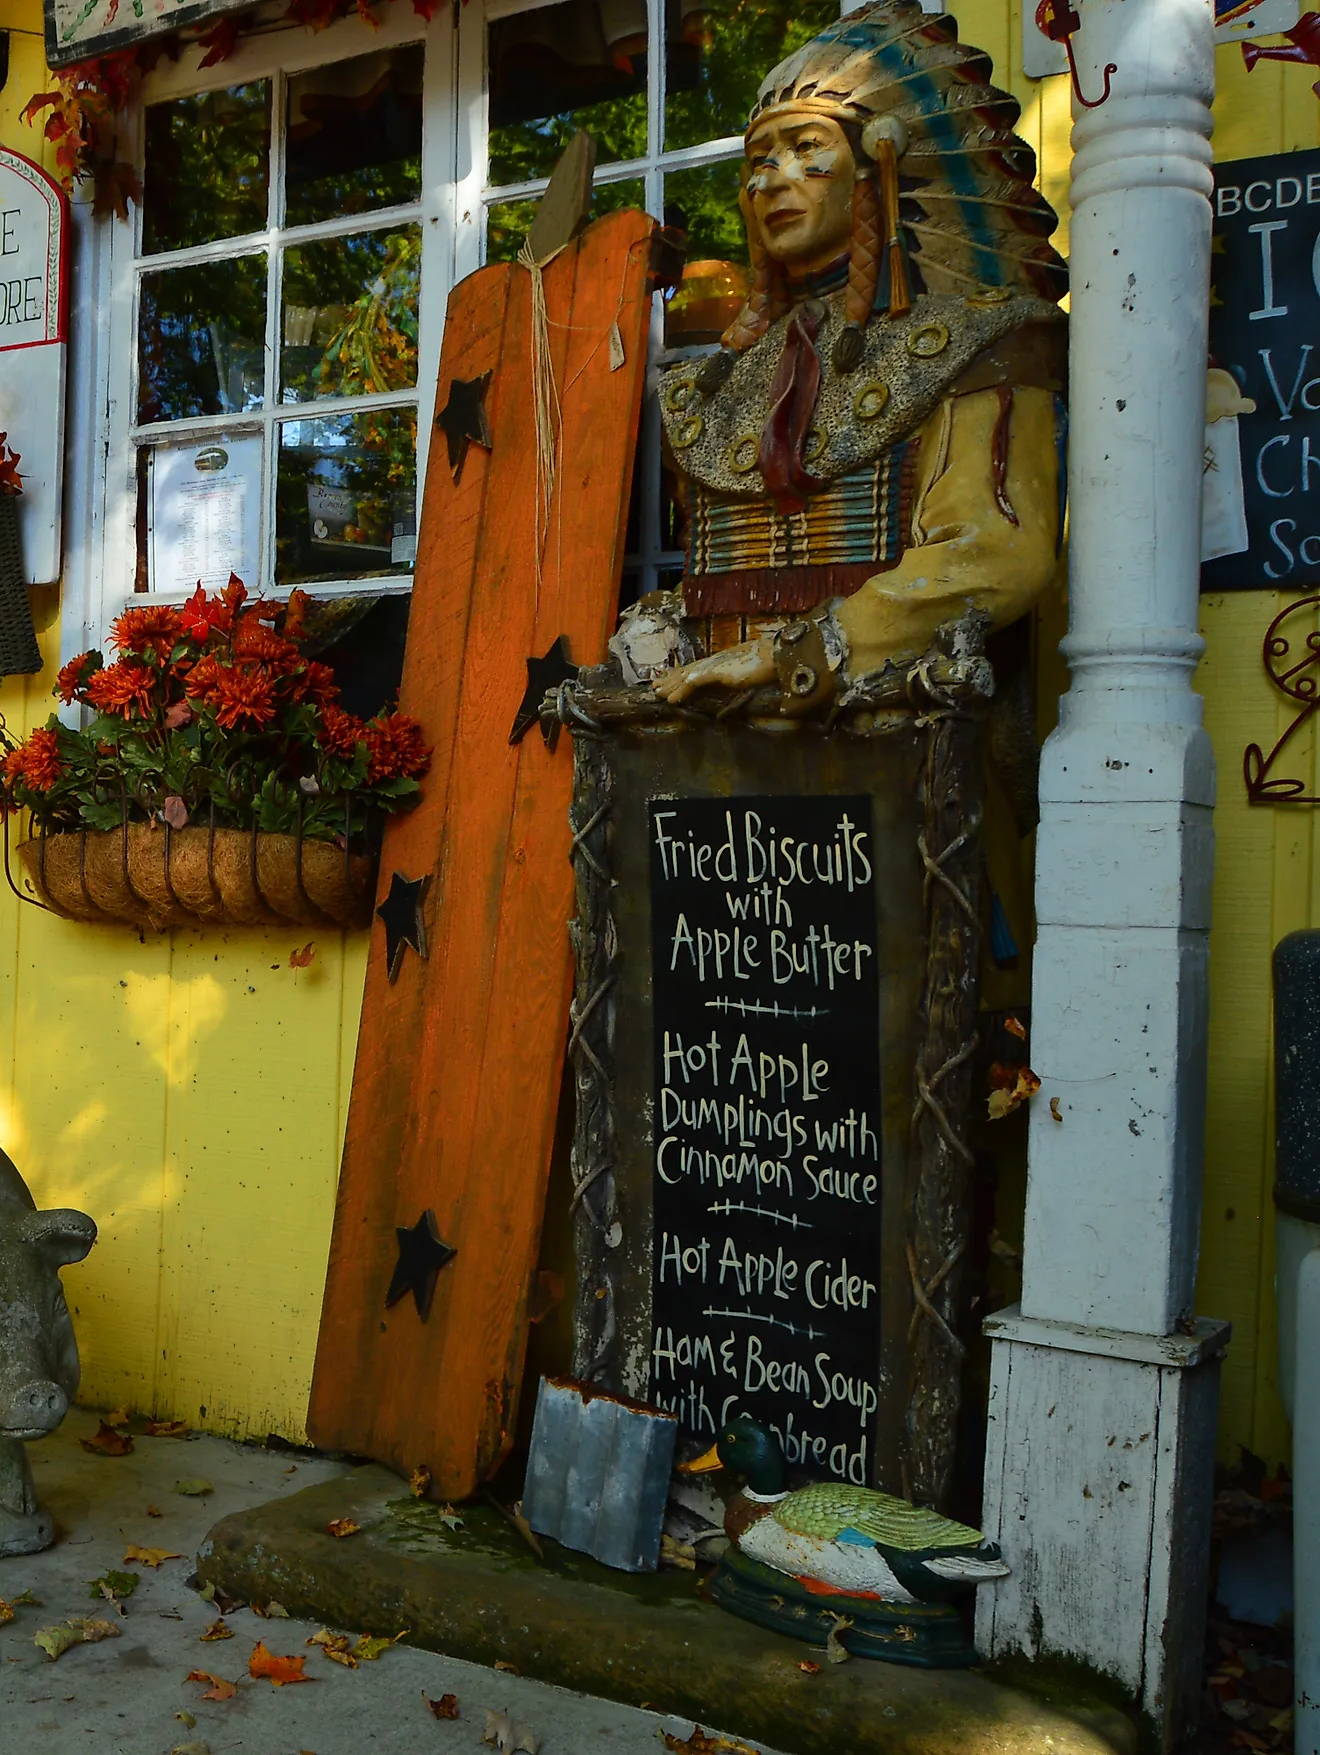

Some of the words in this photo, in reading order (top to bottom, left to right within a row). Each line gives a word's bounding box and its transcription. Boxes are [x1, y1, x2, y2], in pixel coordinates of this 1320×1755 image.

[653, 810, 738, 882] Fried
[745, 810, 872, 892] Biscuits
[726, 881, 793, 928] with
[771, 924, 872, 991] Butter
[663, 1030, 722, 1086] Hot
[815, 1108, 878, 1161] with
[802, 1155, 878, 1204] Sauce
[660, 1232, 711, 1285] Hot
[805, 1258, 877, 1312] Cider
[744, 1335, 810, 1400] Bean
[813, 1352, 878, 1428] Soup
[721, 1394, 867, 1487] Cbread
